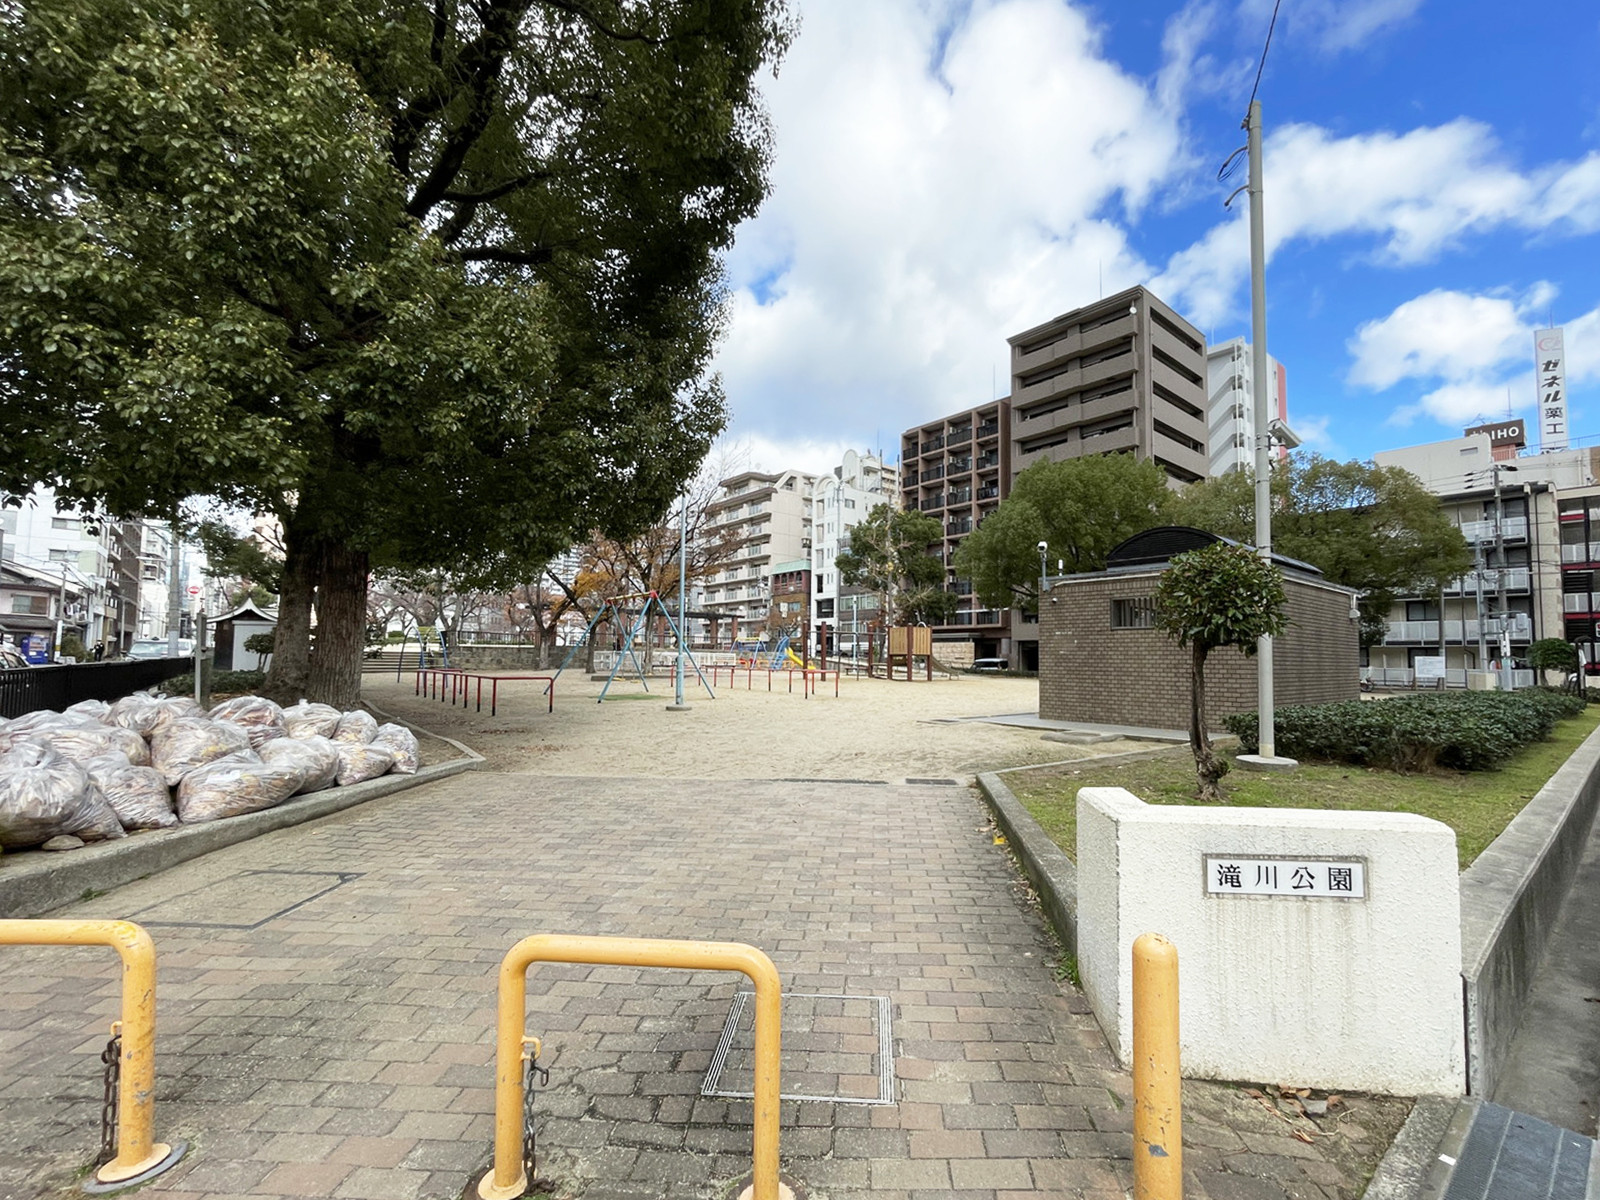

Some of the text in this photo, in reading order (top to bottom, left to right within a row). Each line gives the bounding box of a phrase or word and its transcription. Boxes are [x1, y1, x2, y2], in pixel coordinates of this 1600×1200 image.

[1541, 358, 1564, 435] ゼネル薬工
[1217, 864, 1352, 891] 滝川公園
